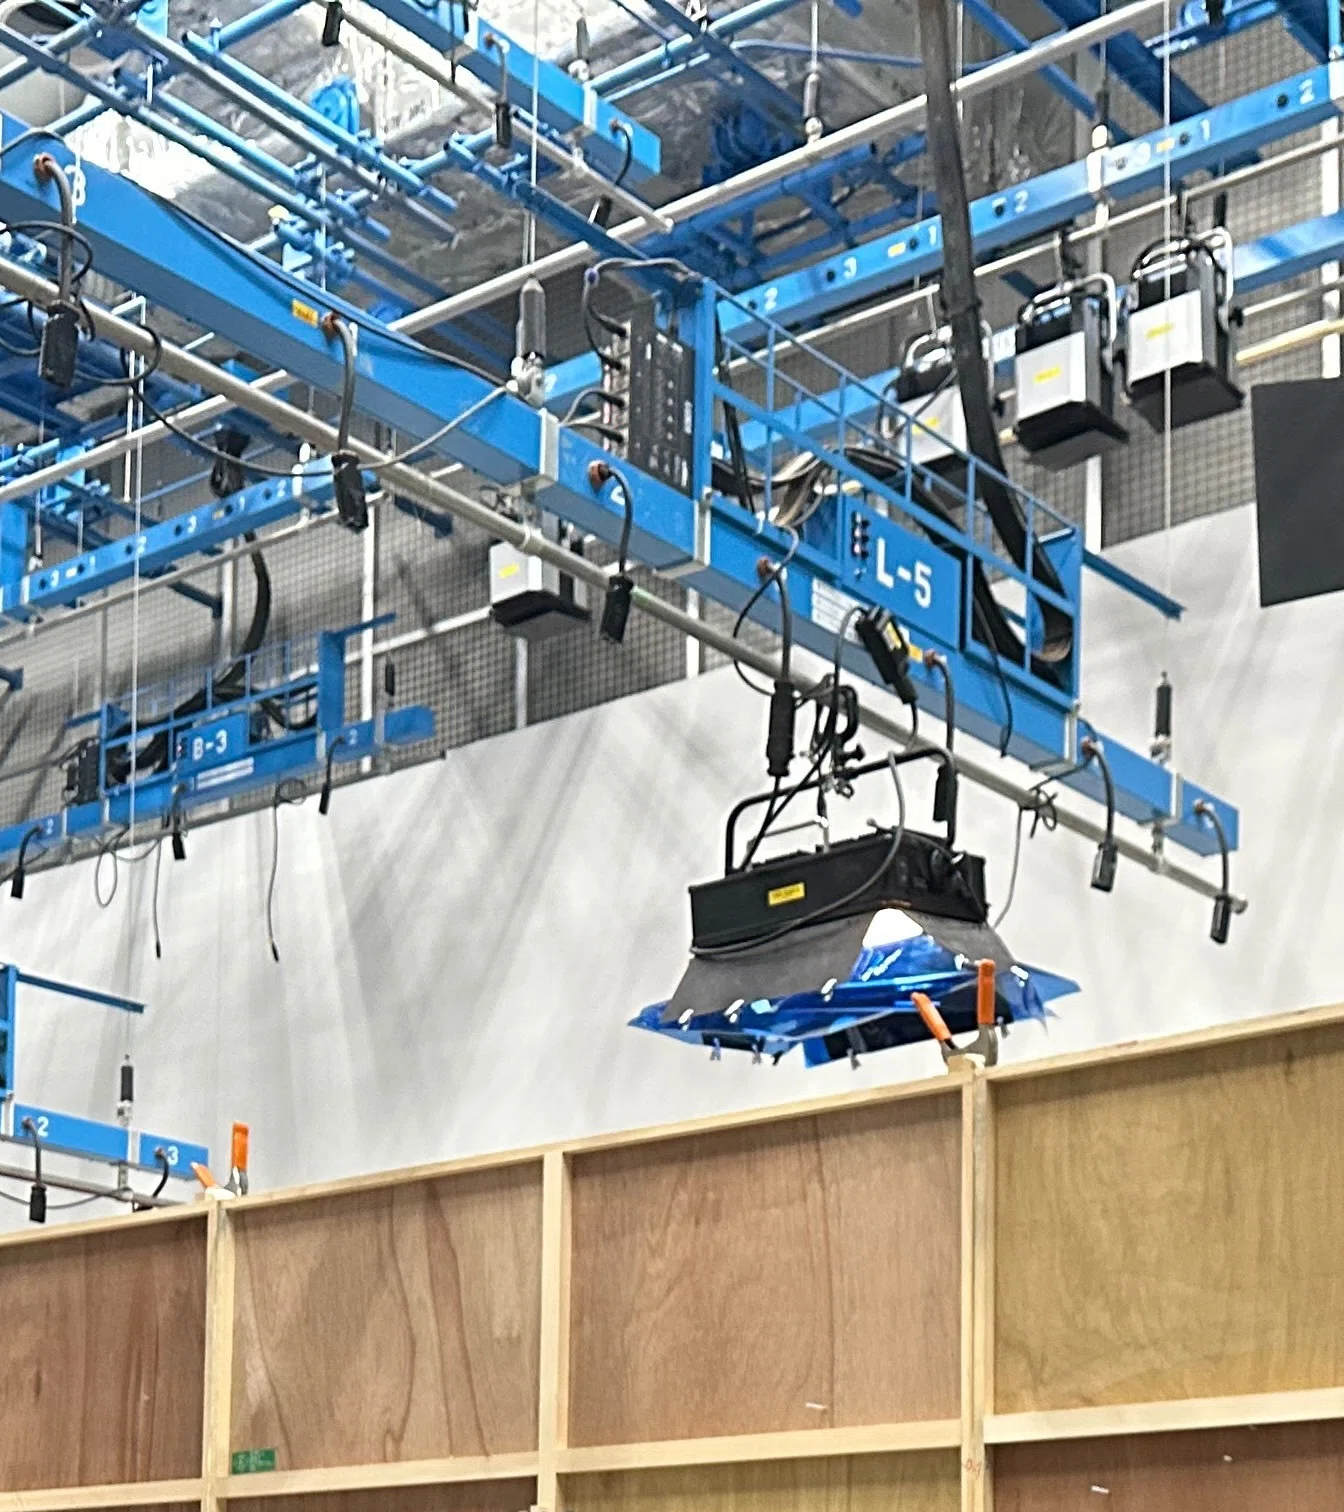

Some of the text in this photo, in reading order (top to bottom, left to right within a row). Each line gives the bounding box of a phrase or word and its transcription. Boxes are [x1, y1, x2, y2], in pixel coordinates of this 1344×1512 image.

[843, 257, 858, 279] 3
[874, 536, 934, 609] L-5
[37, 1115, 49, 1138] 2
[167, 1145, 179, 1166] 3
